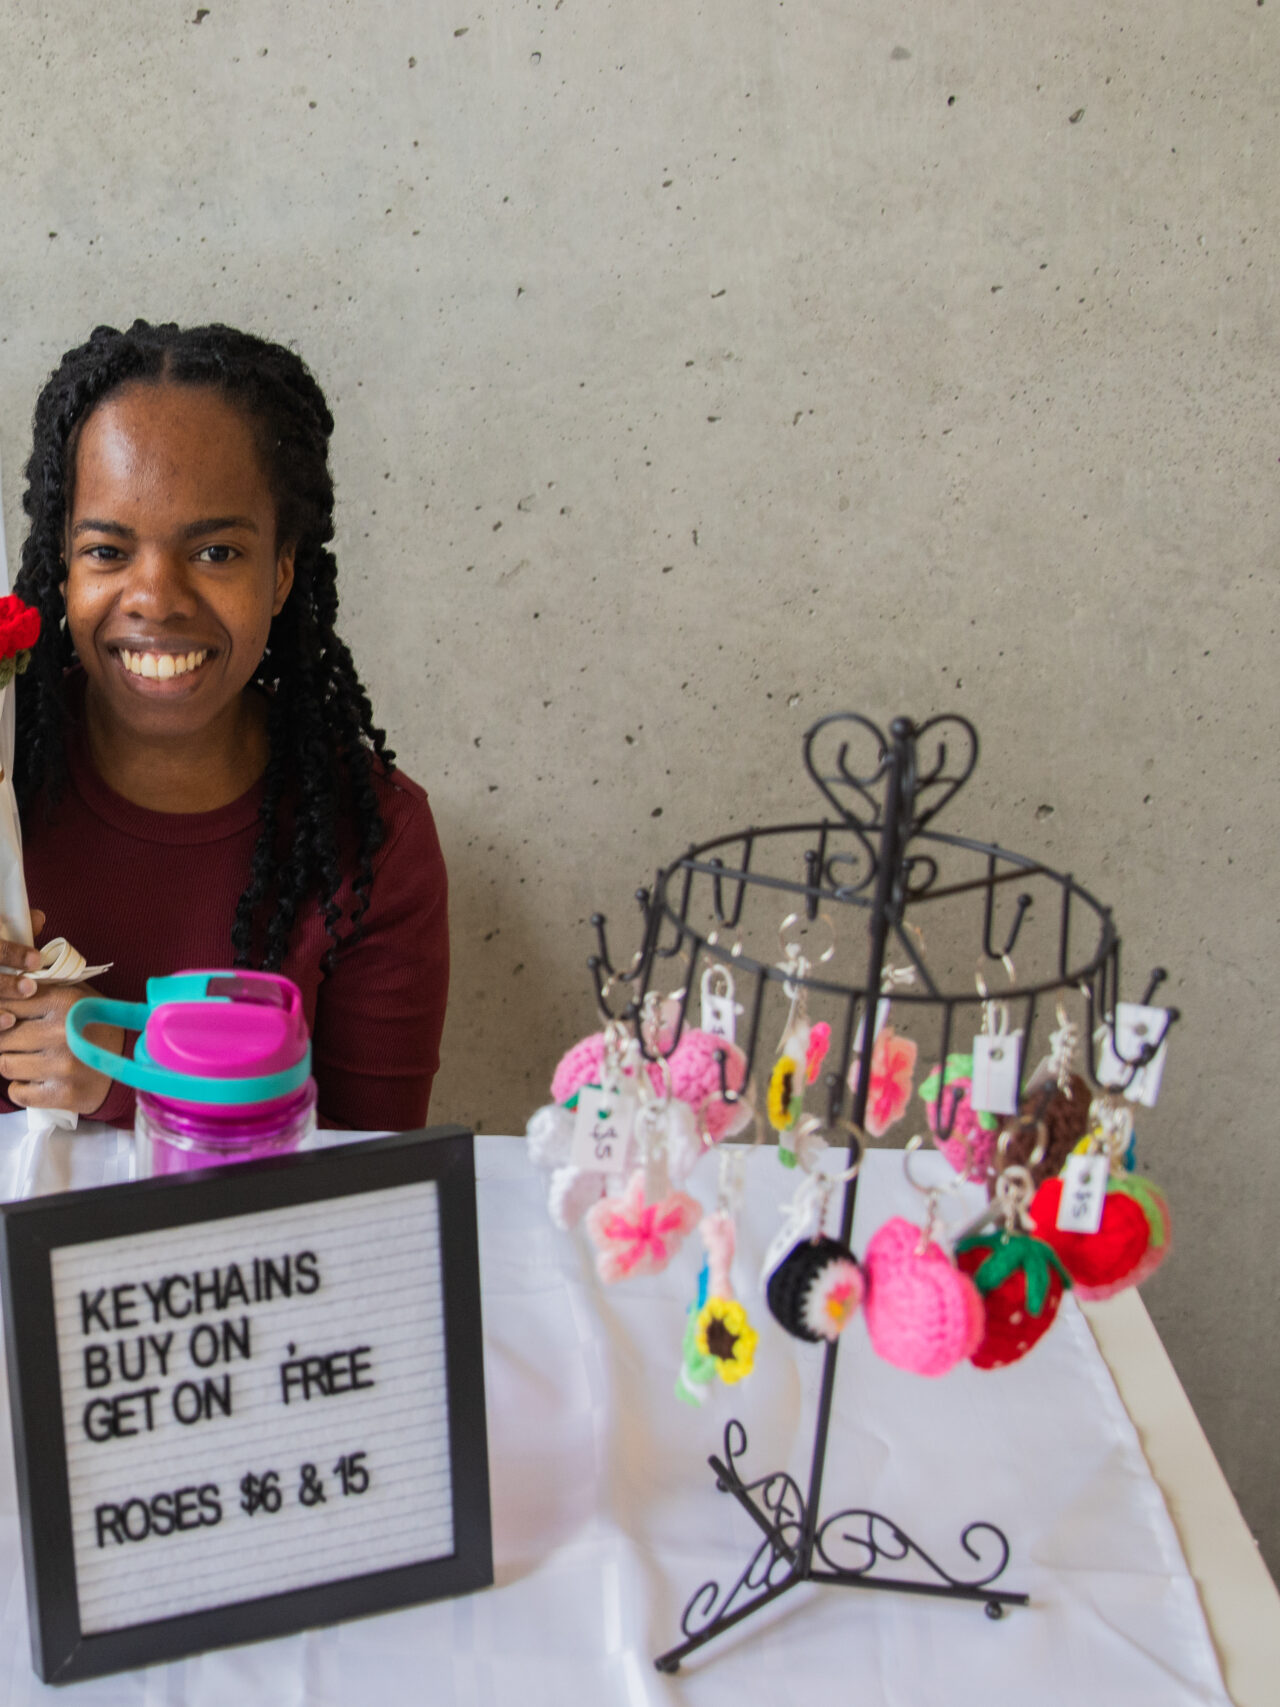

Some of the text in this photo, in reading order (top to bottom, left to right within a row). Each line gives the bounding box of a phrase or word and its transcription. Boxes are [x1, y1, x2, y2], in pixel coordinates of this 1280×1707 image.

[79, 1251, 320, 1335] KEYCHAINS
[82, 1346, 375, 1443] GET ON FREE
[84, 1331, 174, 1389] BUY
[189, 1316, 251, 1369] ON
[95, 1452, 369, 1548] ROSES $6 & 15
